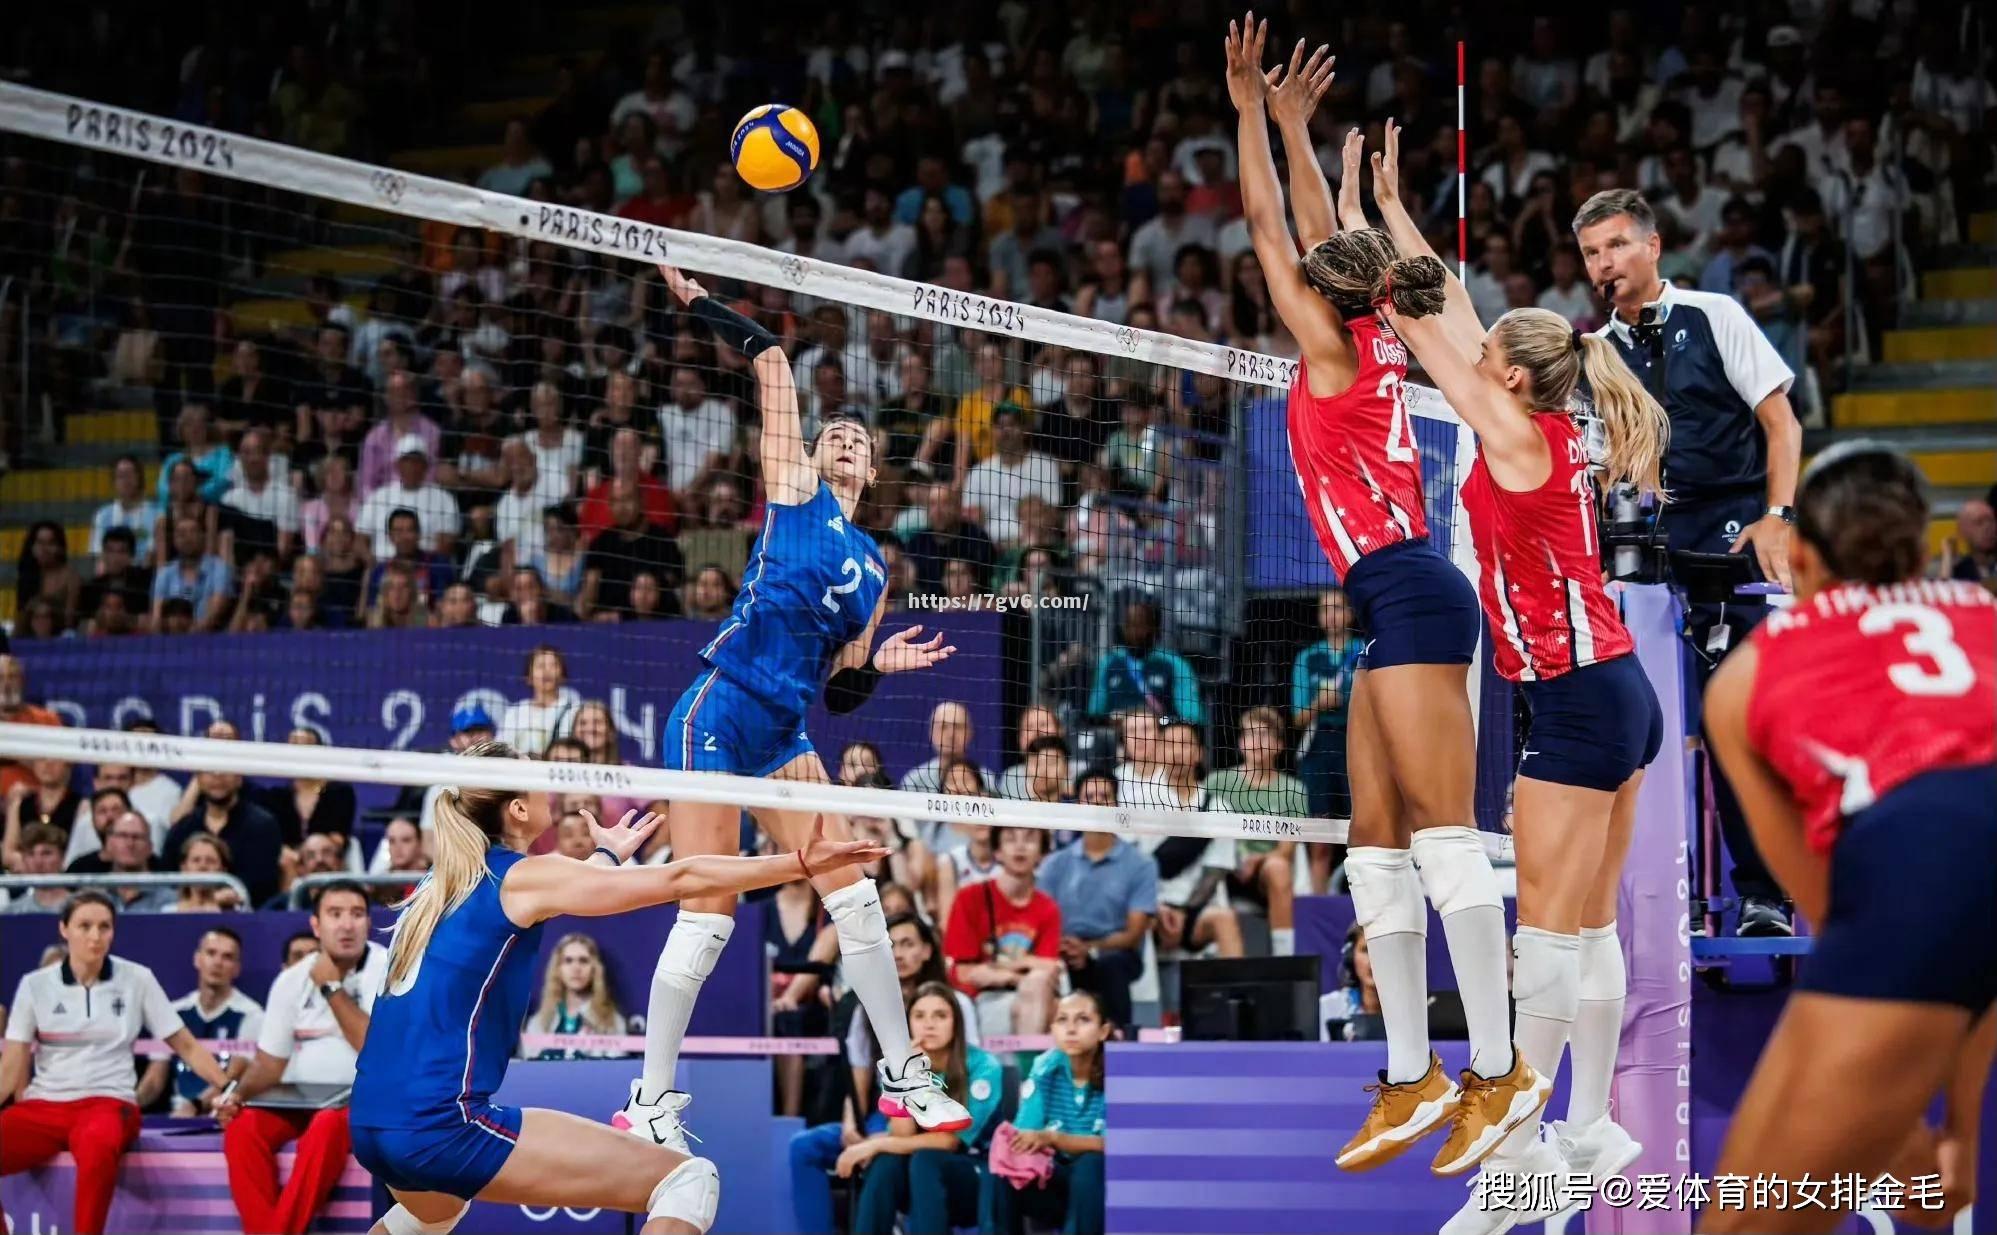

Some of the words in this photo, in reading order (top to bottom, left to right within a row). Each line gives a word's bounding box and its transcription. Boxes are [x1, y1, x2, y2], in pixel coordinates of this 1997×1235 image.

[160, 125, 234, 168] 2024
[610, 222, 668, 257] 2024
[977, 300, 1024, 331] 2024
[822, 557, 862, 613] 2
[1858, 603, 1976, 697] 3
[381, 687, 657, 760] 24
[703, 731, 717, 752] 2
[1275, 820, 1302, 836] 2024
